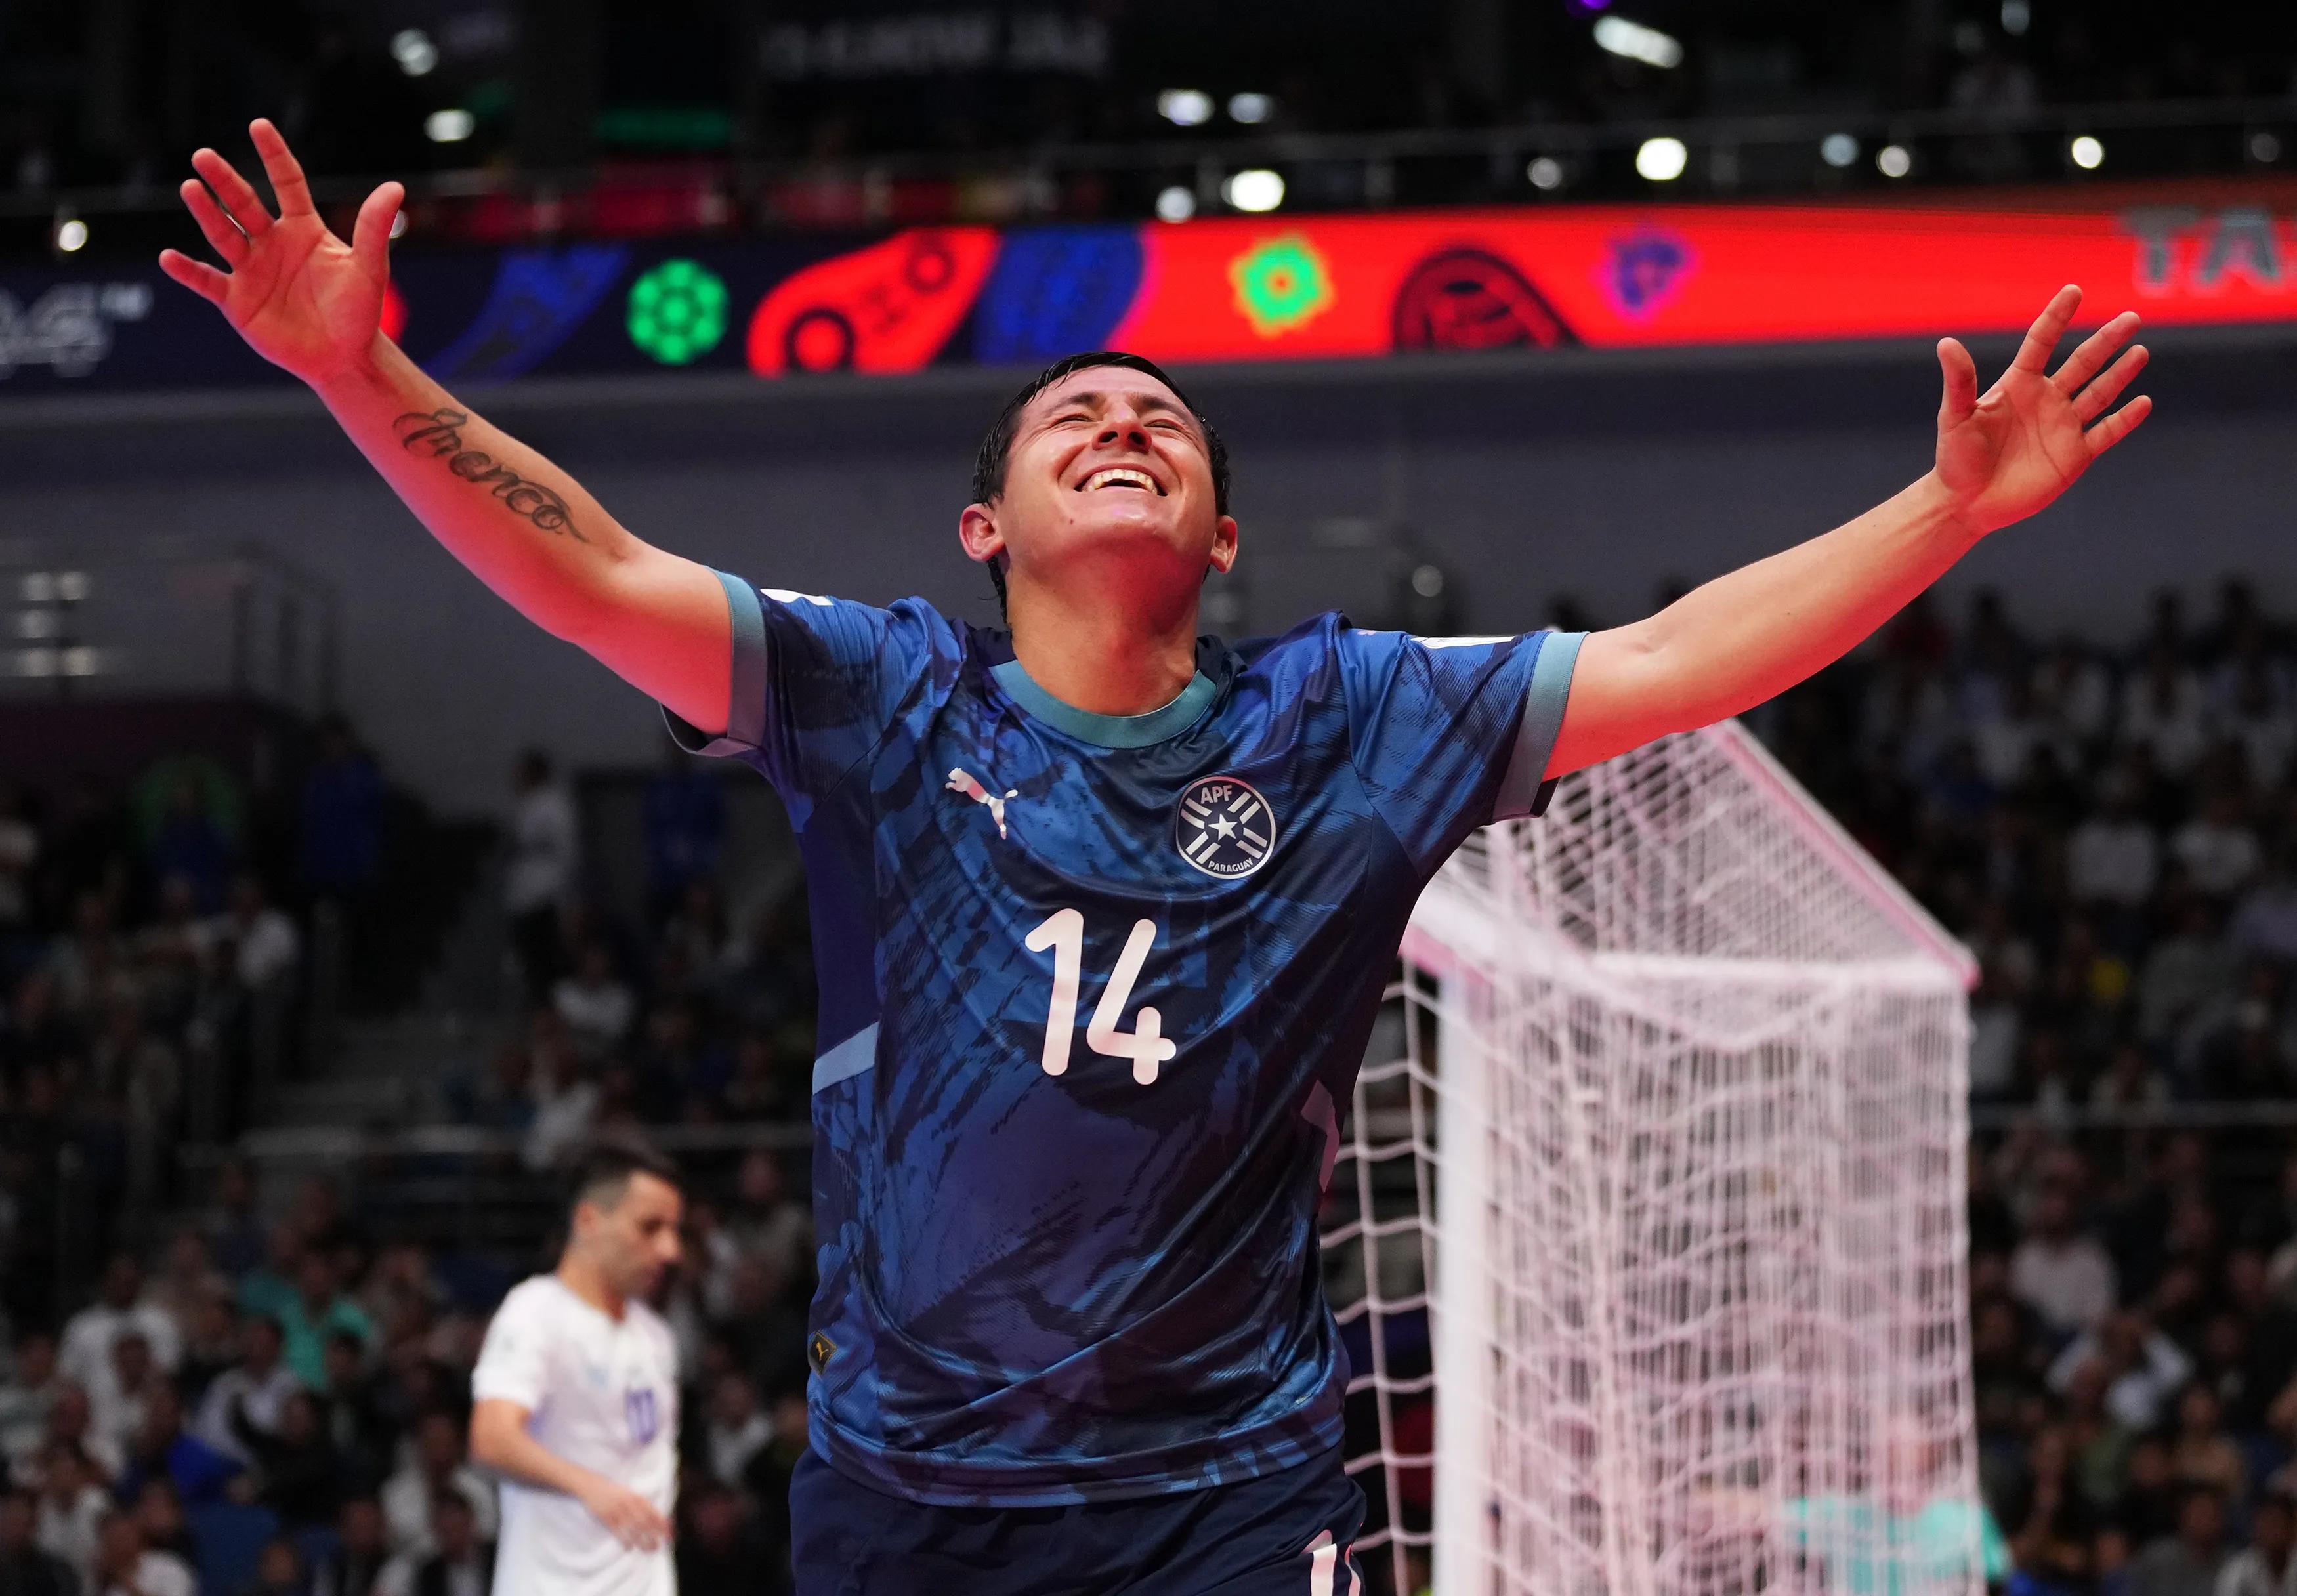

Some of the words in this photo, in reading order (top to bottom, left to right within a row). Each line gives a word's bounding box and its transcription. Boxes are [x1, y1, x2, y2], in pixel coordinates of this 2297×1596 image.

[1200, 784, 1233, 804] APF
[1208, 857, 1254, 872] PARAGUAY
[1025, 908, 1177, 1085] 14
